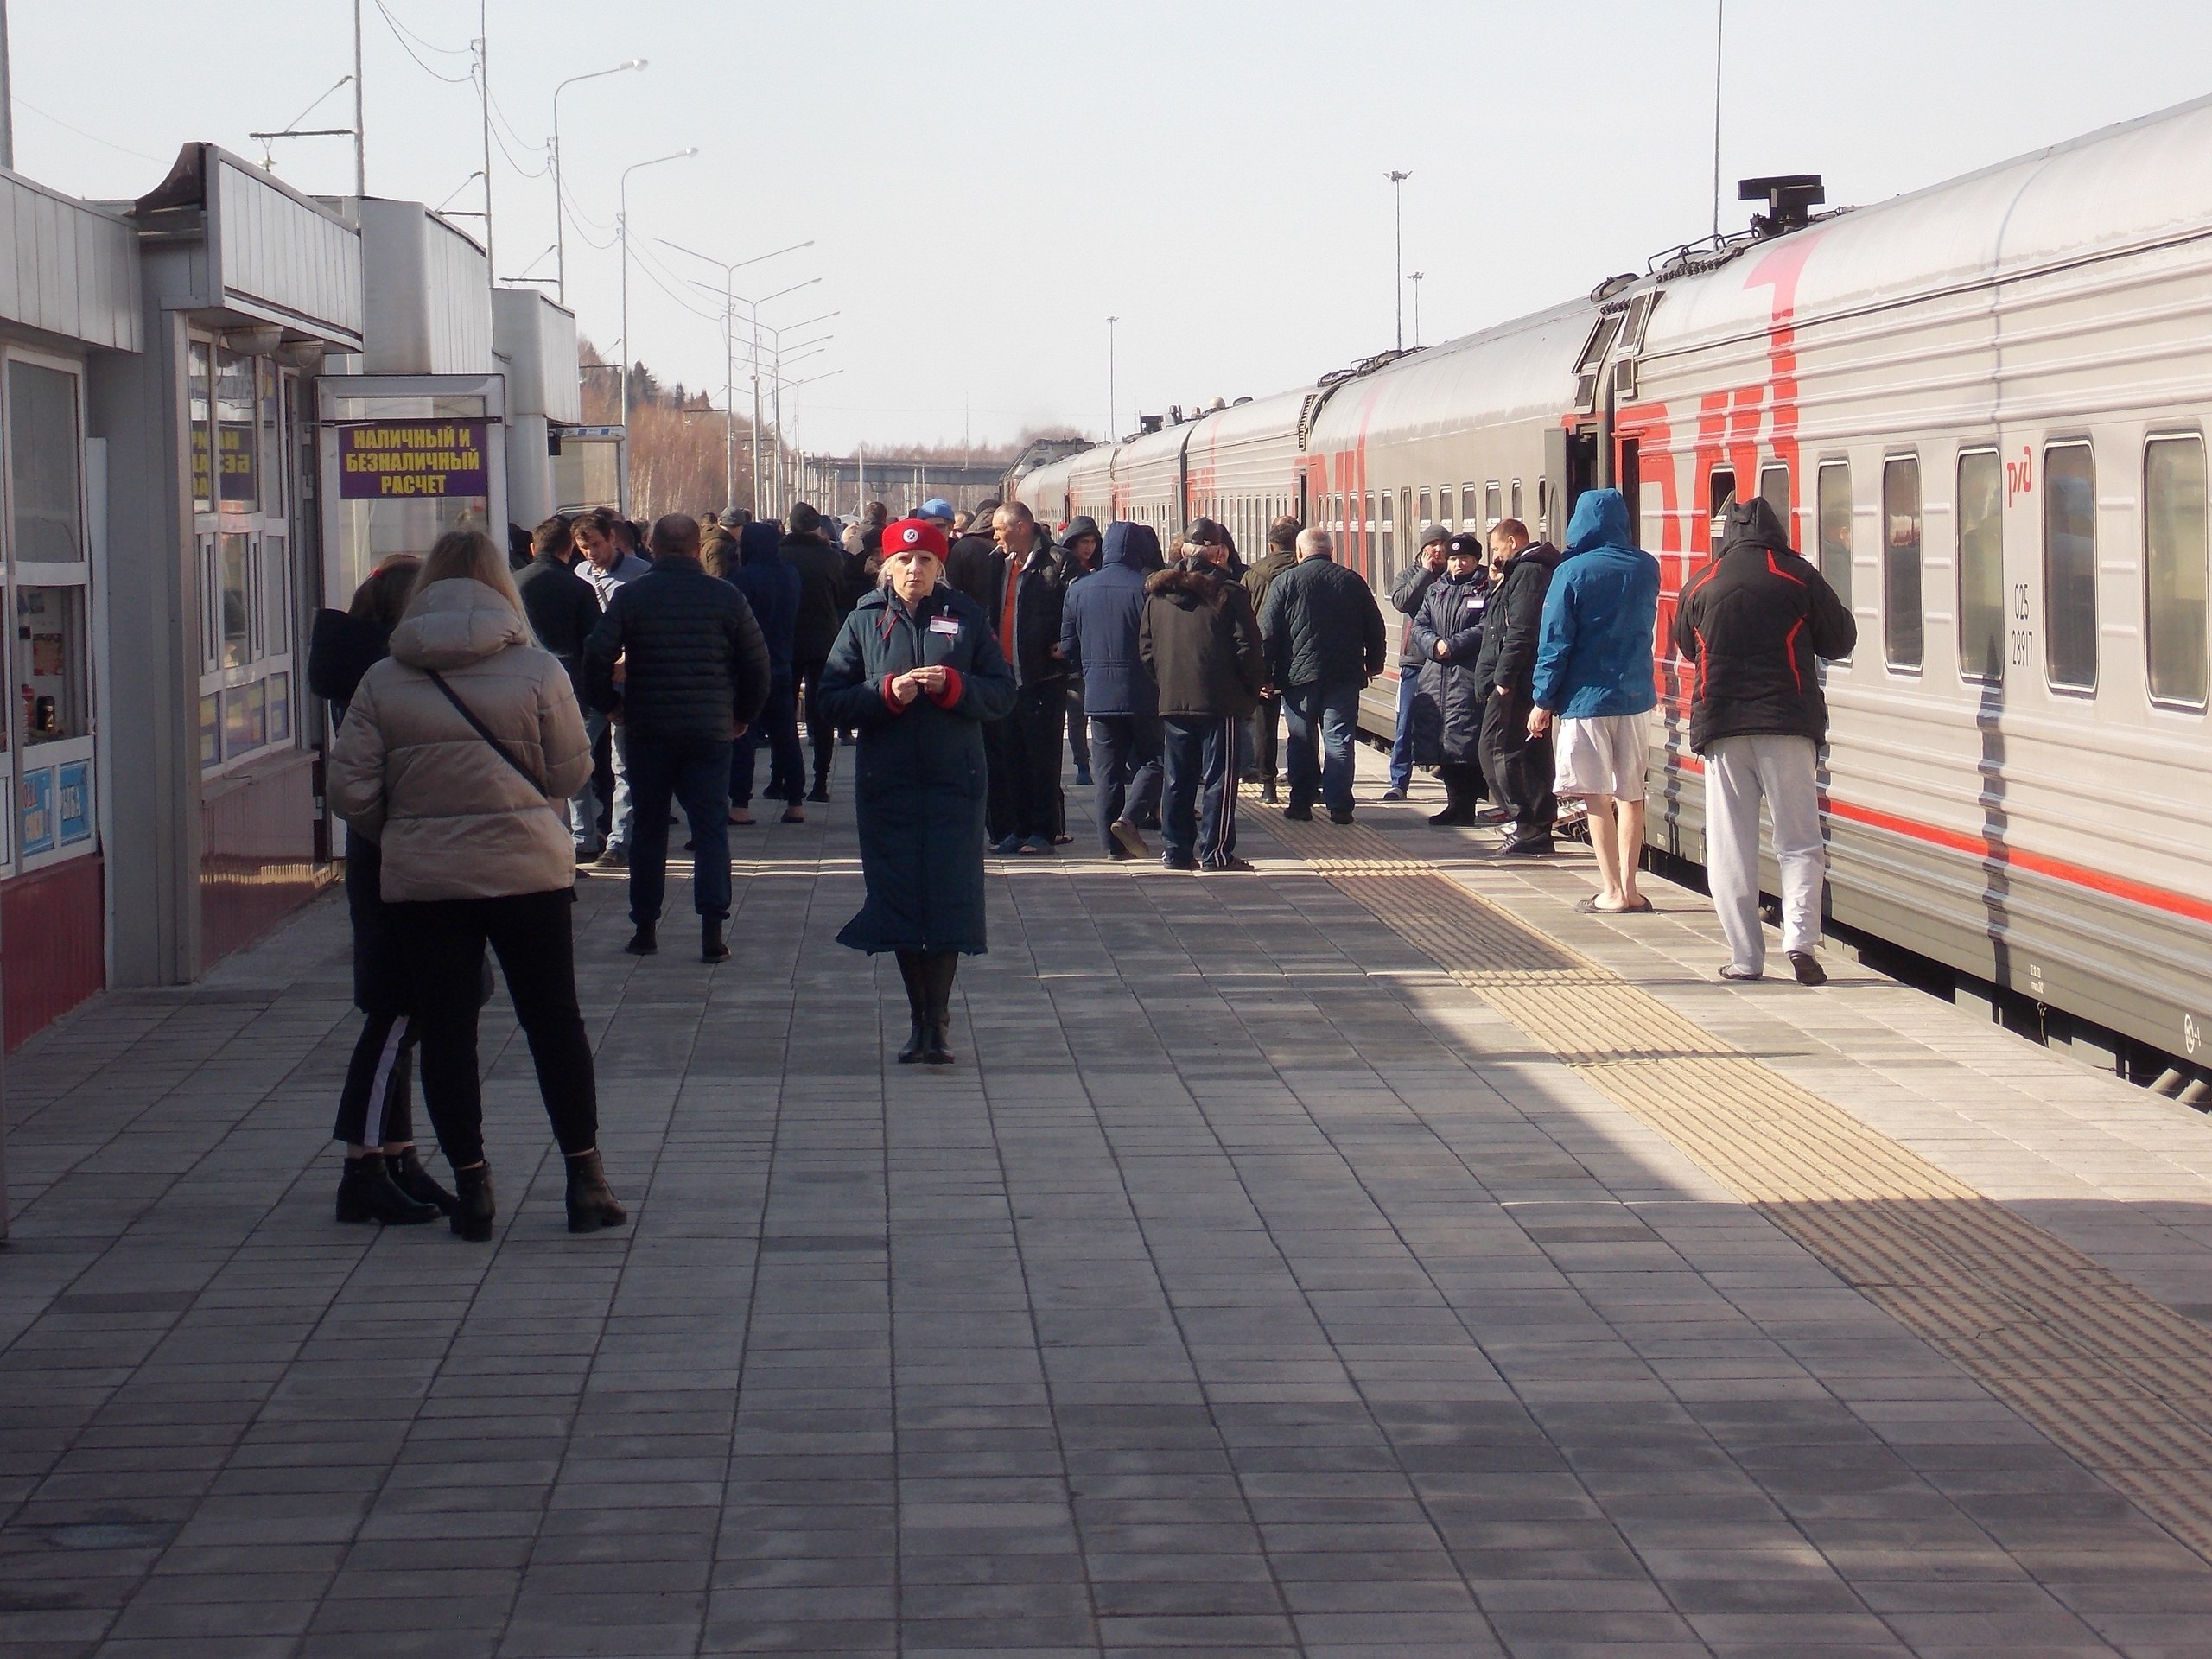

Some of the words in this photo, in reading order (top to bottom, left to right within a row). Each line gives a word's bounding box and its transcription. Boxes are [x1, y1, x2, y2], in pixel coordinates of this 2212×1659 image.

[353, 425, 454, 448] НАЛИЧНЫЙ
[459, 429, 470, 448] И
[346, 448, 480, 472] БЕЗНАЛИЧНЫЙ
[381, 474, 447, 494] РАСЧЕТ
[2014, 583, 2029, 620] 025
[2012, 629, 2032, 667] 28917
